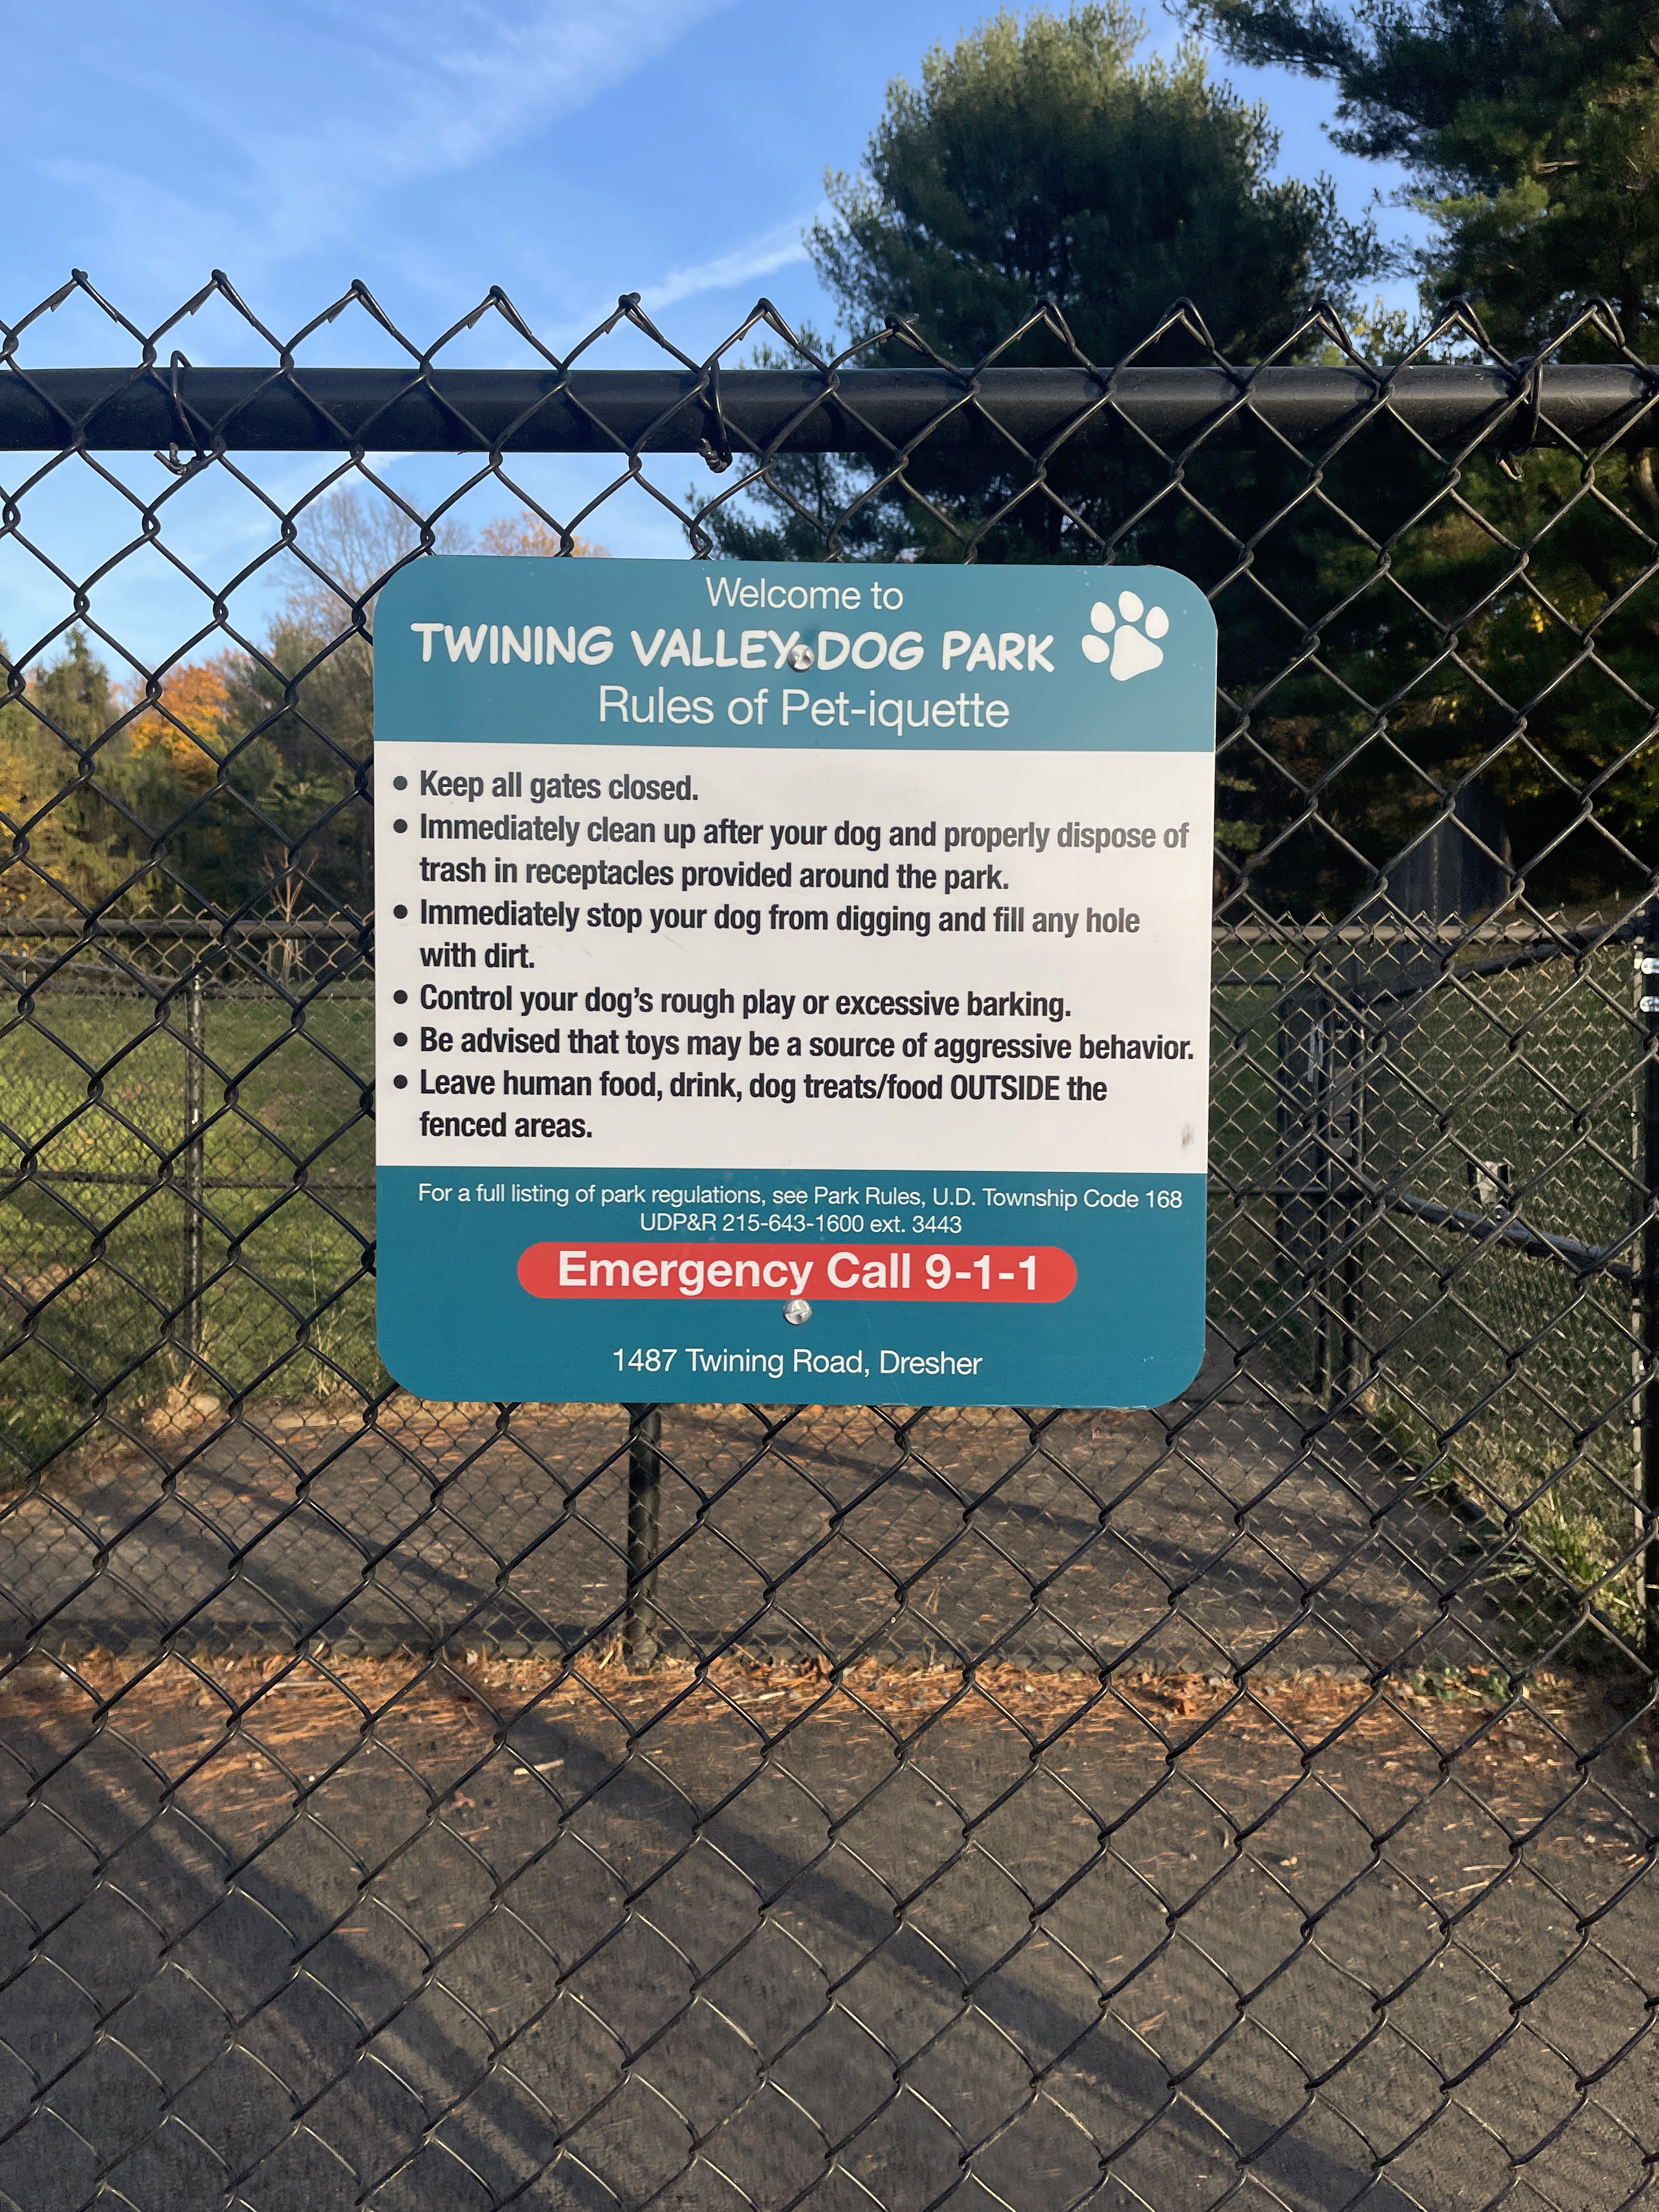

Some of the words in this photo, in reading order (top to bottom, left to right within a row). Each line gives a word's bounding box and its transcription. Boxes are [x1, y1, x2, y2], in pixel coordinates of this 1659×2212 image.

[705, 577, 861, 610] Welcome
[870, 582, 904, 610] to
[410, 623, 614, 665] TWINING
[630, 628, 800, 670] VALLEY
[817, 630, 924, 671] DOG
[942, 630, 1055, 673] PARK
[600, 685, 714, 724] Rules
[727, 688, 769, 725] of
[782, 689, 1010, 736] Pet-iquette
[420, 770, 484, 803] Keep
[492, 771, 522, 798] all
[530, 773, 601, 804] gates
[608, 774, 698, 801] closed.
[421, 813, 580, 847] Immediately
[587, 816, 656, 843] clean
[664, 823, 696, 849] up
[703, 818, 764, 844] after
[769, 825, 828, 850] your
[834, 820, 881, 852] dog
[889, 821, 936, 847] and
[944, 821, 1051, 853] properly
[1057, 821, 1156, 854] dispose
[1164, 822, 1189, 848] of
[419, 856, 486, 883] trash
[495, 856, 518, 883] in
[526, 860, 674, 890] receptacles
[681, 860, 792, 891] provided
[799, 863, 889, 889] around
[895, 863, 937, 889] the
[944, 864, 1009, 895] park.
[421, 898, 580, 933] Immediately
[586, 902, 642, 934] stop
[649, 908, 708, 934] your
[714, 904, 761, 935] dog
[768, 904, 828, 930] from
[836, 905, 930, 938] digging
[939, 906, 986, 932] and
[992, 906, 1024, 932] fill
[1032, 912, 1080, 938] any
[1086, 907, 1140, 933] hole
[419, 941, 476, 968] with
[484, 942, 535, 969] dirt.
[420, 984, 512, 1011] Control
[520, 991, 578, 1017] your
[585, 986, 653, 1018] dog’s
[661, 988, 735, 1019] rough
[742, 989, 797, 1020] play
[803, 995, 830, 1015] or
[836, 990, 960, 1016] excessive
[967, 991, 1071, 1023] barking.
[420, 1026, 454, 1052] Be
[461, 1027, 560, 1054] advised
[567, 1028, 619, 1054] that
[624, 1030, 680, 1060] toys
[687, 1035, 742, 1062] may
[749, 1030, 780, 1056] be
[787, 1036, 802, 1057] a
[809, 1037, 895, 1057] source
[902, 1032, 928, 1058] of
[934, 1032, 1072, 1064] aggressive
[1080, 1034, 1194, 1060] behavior.
[420, 1069, 496, 1095] Leave
[503, 1069, 592, 1096] human
[599, 1070, 663, 1102] food,
[670, 1071, 742, 1103] drink,
[749, 1073, 796, 1104] dog
[803, 1073, 943, 1099] treats/food
[950, 1074, 1060, 1101] OUTSIDE
[1066, 1075, 1108, 1101] the
[419, 1110, 507, 1137] fenced
[515, 1118, 592, 1138] areas.
[419, 1183, 453, 1201] For
[458, 1188, 471, 1202] a
[476, 1183, 505, 1202] full
[512, 1184, 569, 1207] listing
[575, 1184, 596, 1203] of
[601, 1184, 646, 1207] park
[652, 1185, 766, 1207] regulations,
[772, 1190, 808, 1204] see
[815, 1186, 860, 1204] Park
[866, 1187, 926, 1208] Rules,
[933, 1187, 975, 1206] U.D.
[982, 1188, 1077, 1211] Township
[1084, 1189, 1139, 1208] Code
[1146, 1190, 1182, 1209] 168
[641, 1212, 716, 1231] UDP&R
[723, 1214, 864, 1232] 215-643-1600
[870, 1216, 905, 1233] ext.
[912, 1215, 962, 1234] 3443
[559, 1250, 814, 1296] Emergency
[827, 1251, 910, 1289] Call
[925, 1254, 1035, 1290] 9-1-1
[613, 1348, 678, 1372] 1487
[685, 1348, 783, 1379] Twining
[793, 1348, 870, 1378] Road,
[880, 1350, 983, 1375] Dresher
